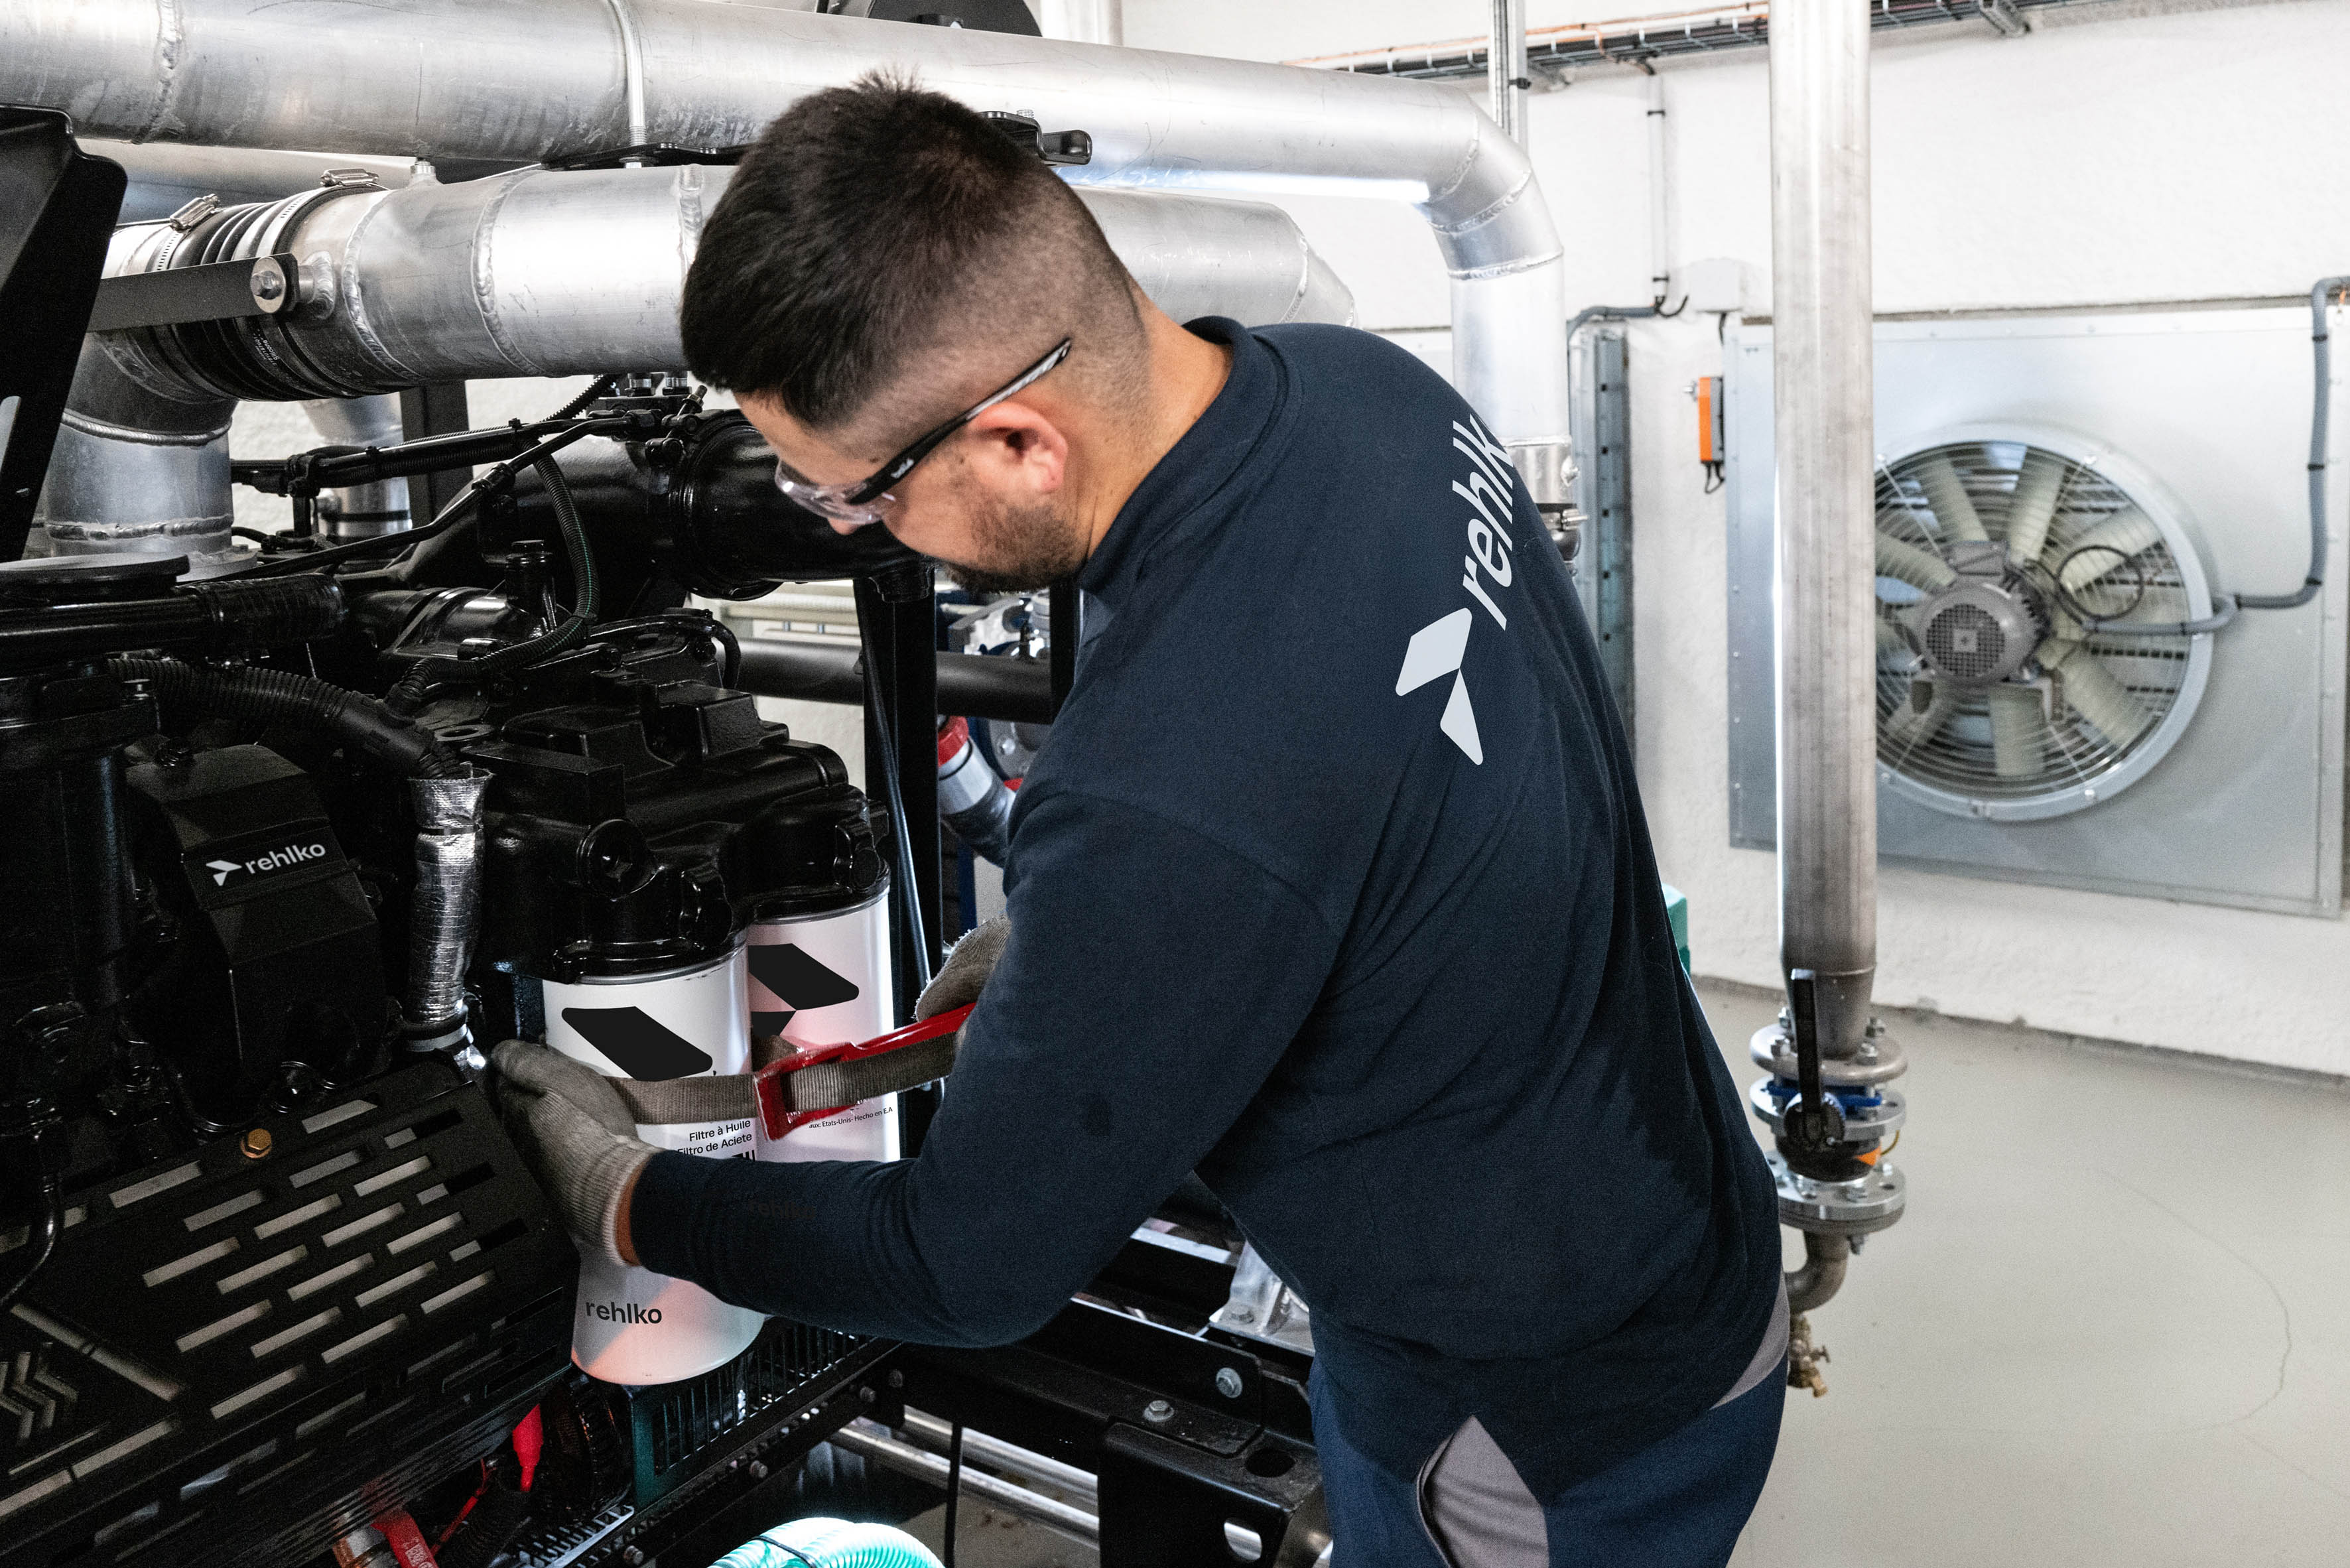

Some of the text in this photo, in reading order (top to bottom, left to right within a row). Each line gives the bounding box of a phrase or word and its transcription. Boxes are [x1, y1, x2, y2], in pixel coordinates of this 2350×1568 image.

[245, 844, 326, 874] rehlko
[854, 1113, 874, 1122] Hecho
[690, 1120, 751, 1142] Filtre à Huile
[677, 1134, 752, 1155] Filtro de Aciete
[585, 1301, 663, 1324] rehlko
